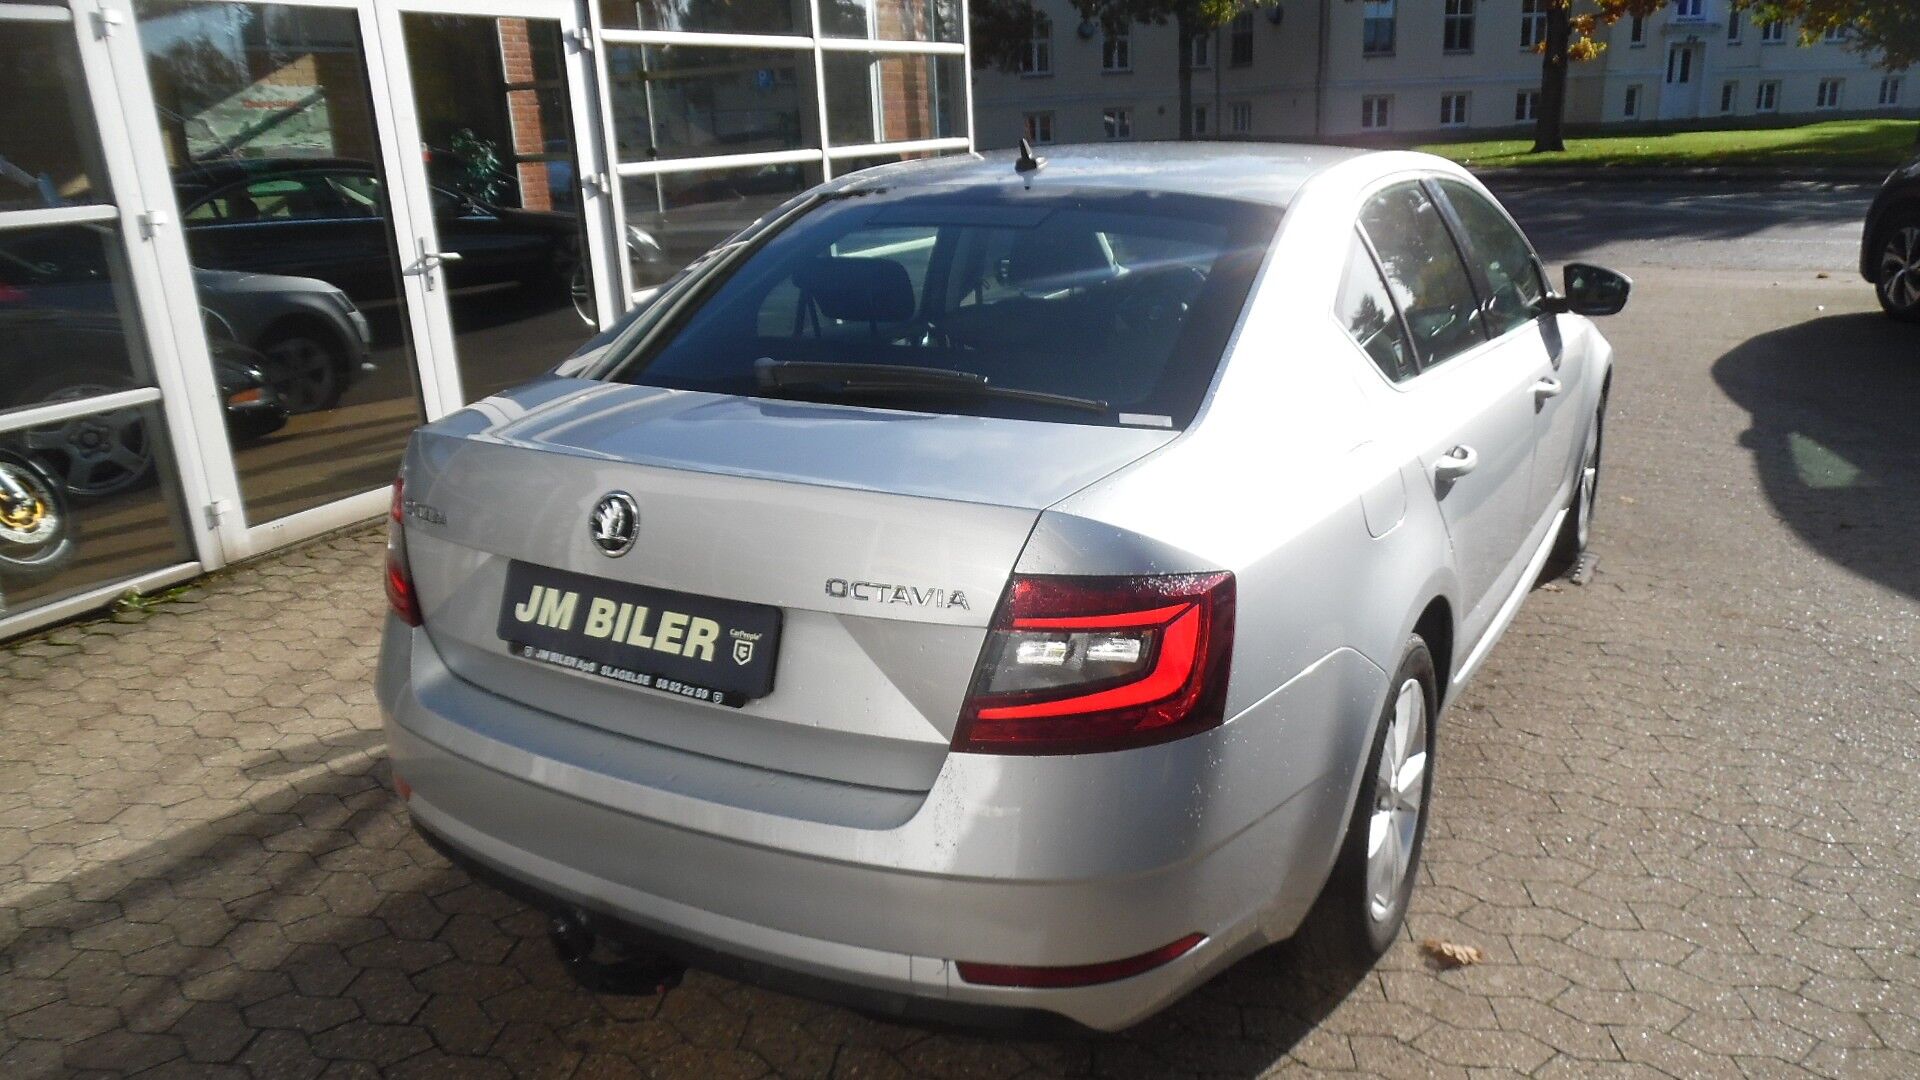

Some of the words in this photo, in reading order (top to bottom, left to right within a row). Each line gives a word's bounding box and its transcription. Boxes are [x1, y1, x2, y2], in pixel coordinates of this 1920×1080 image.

[825, 577, 970, 610] OCTAVIA
[514, 585, 578, 631] JM
[583, 596, 720, 662] BILER
[535, 649, 550, 661] JM
[600, 665, 651, 686] SLAGELSE
[668, 681, 682, 693] 52
[681, 685, 695, 697] 22
